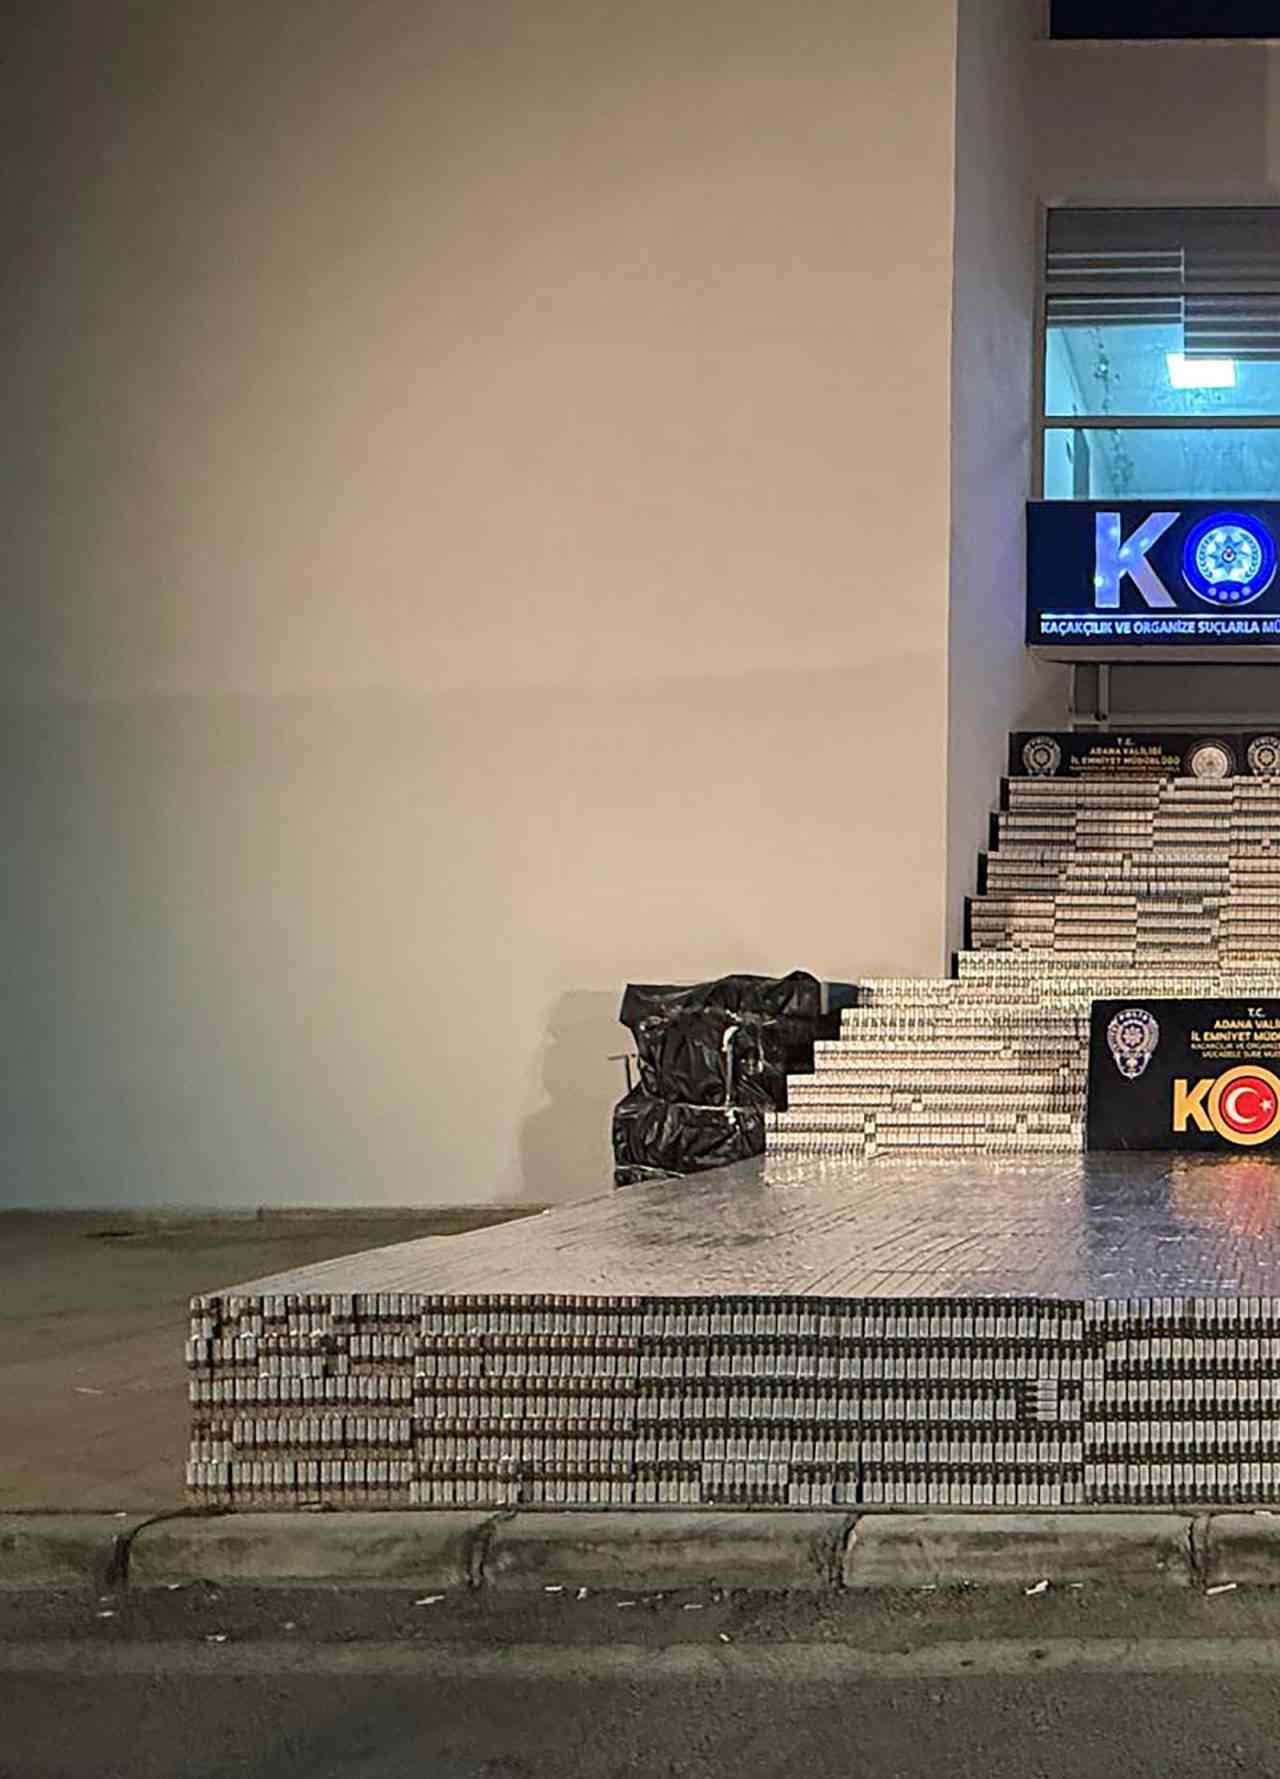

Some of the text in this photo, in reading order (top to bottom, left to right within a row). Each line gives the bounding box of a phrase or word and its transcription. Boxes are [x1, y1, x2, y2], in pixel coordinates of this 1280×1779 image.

[1040, 620, 1114, 637] KAÇAKÇILIK
[1115, 621, 1131, 634] VE
[1133, 619, 1196, 634] ORGANİZE
[1198, 620, 1260, 636] SUÇLARLA
[1214, 1019, 1253, 1029] ADANA
[1191, 1030, 1201, 1041] İL
[1203, 1031, 1251, 1041] EMNİYET
